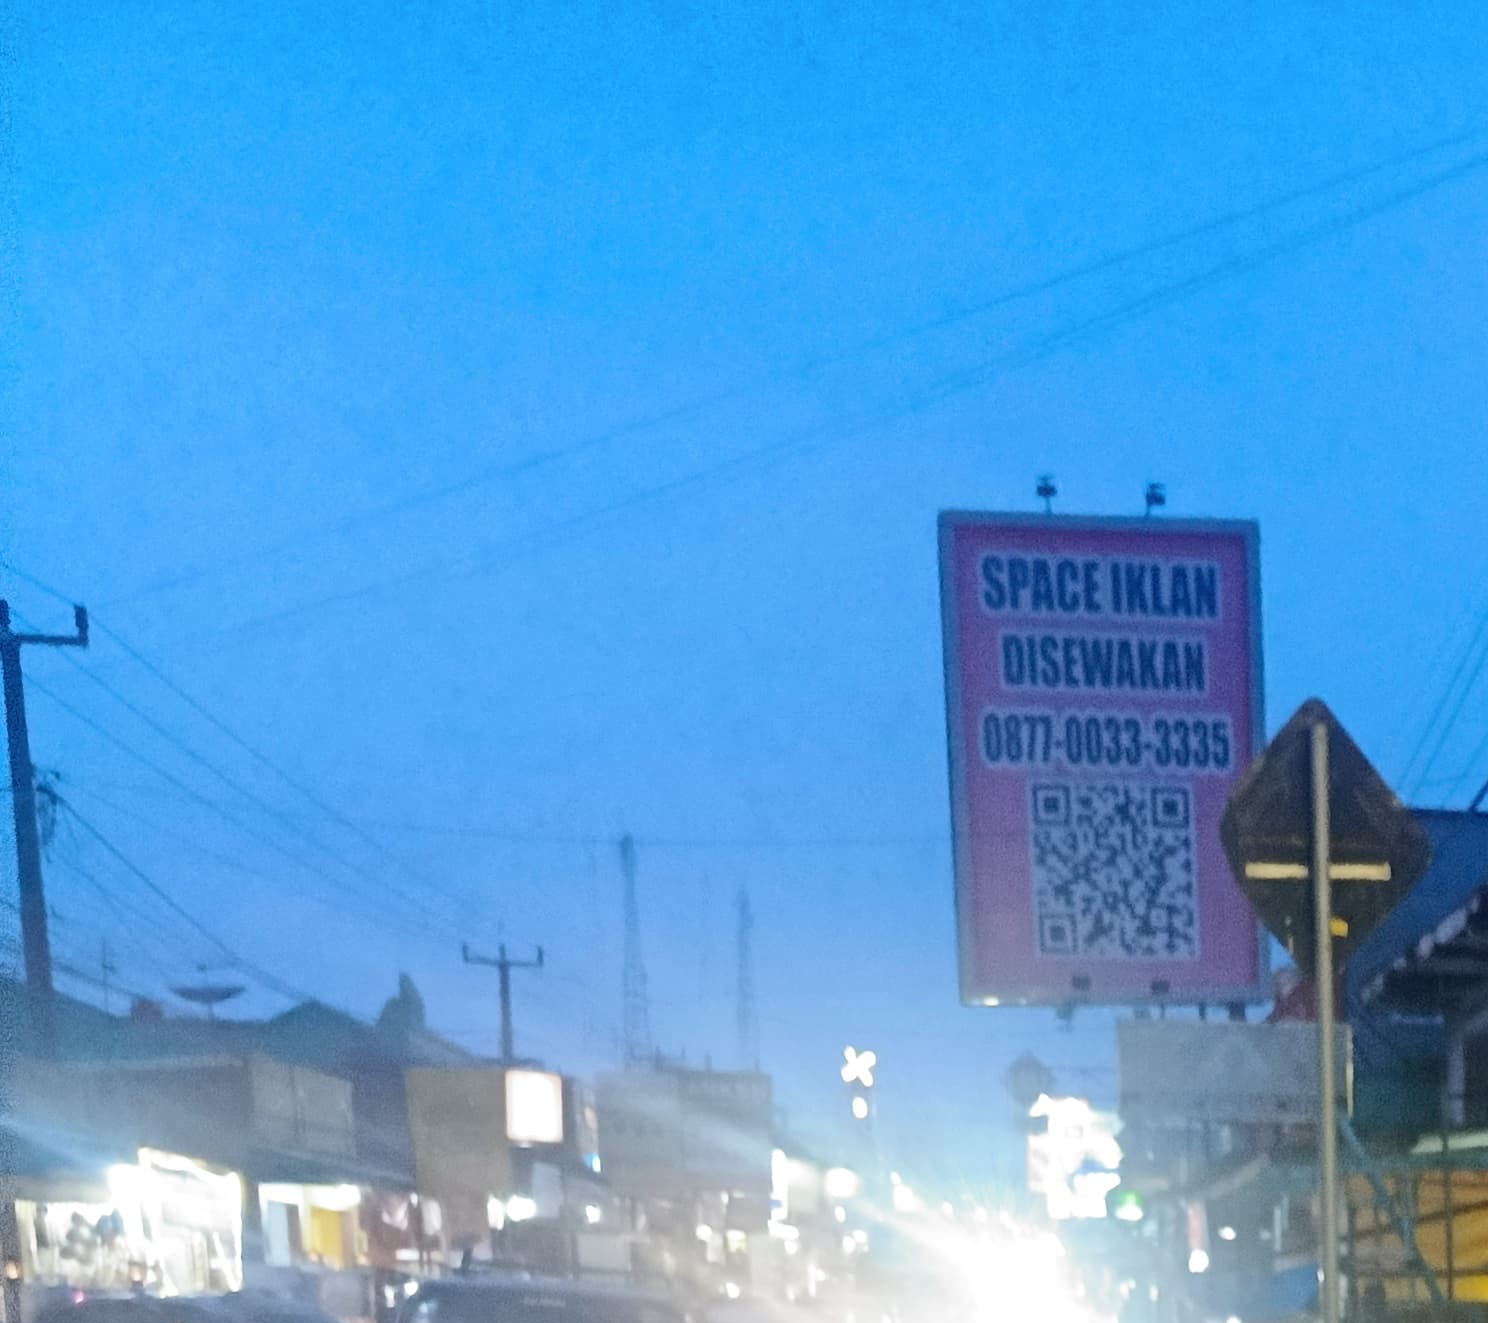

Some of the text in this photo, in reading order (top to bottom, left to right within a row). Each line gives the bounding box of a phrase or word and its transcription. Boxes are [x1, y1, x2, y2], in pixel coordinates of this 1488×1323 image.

[982, 555, 1218, 618] SPACE IKLAN
[1003, 635, 1206, 691] DISEWAKAN
[982, 714, 1232, 769] 0877-0033-3335
